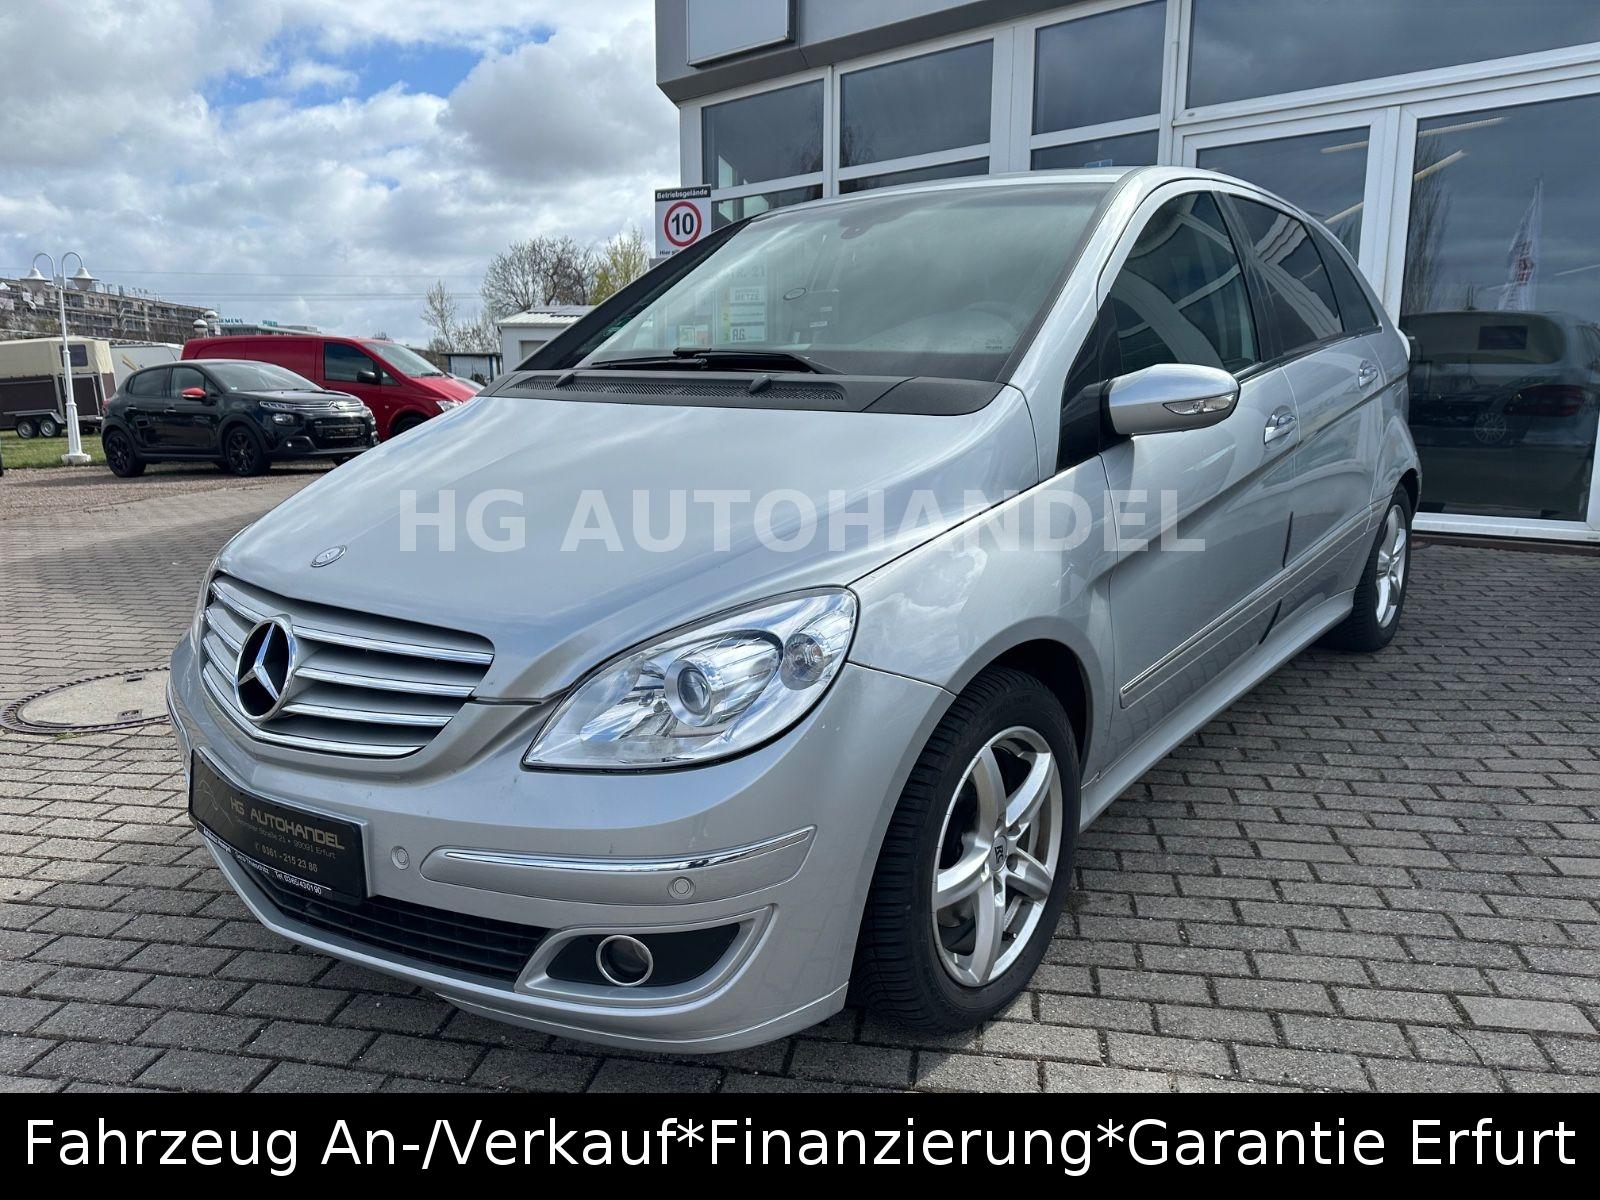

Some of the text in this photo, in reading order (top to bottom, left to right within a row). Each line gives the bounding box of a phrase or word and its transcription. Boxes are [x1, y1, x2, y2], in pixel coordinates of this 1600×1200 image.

[656, 189, 708, 199] Betriebsgelände
[671, 213, 694, 236] 10
[230, 796, 245, 816] HG
[251, 808, 345, 850] AUTOHANDEL
